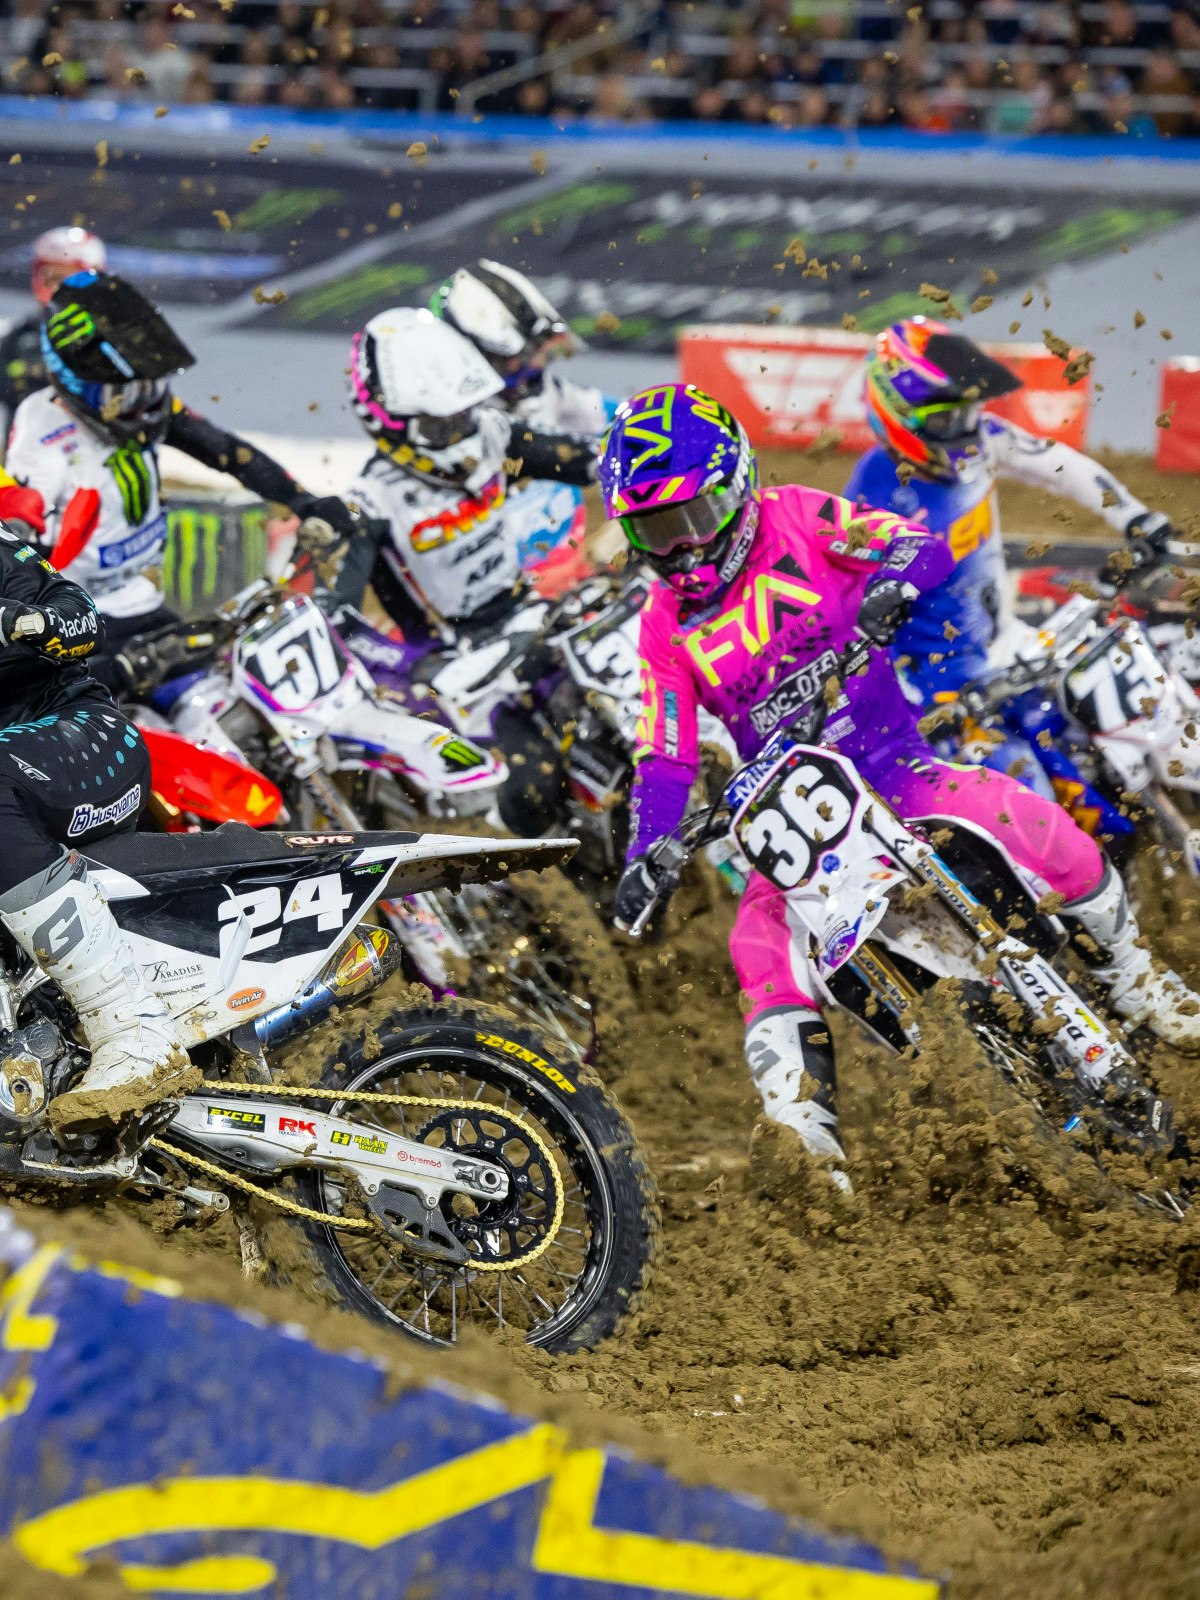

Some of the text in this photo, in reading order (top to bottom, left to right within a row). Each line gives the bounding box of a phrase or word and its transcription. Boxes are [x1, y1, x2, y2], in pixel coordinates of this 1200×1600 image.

[753, 653, 834, 733] MUC-OFF
[89, 787, 140, 827] Husqvarna
[747, 765, 852, 887] 36
[288, 835, 355, 845] GUTS
[353, 864, 386, 876] SMX
[218, 873, 354, 960] 24
[140, 961, 203, 982] PARADISE
[230, 990, 264, 1008] Twin Air
[483, 1034, 577, 1094] DUNLOP
[209, 1108, 264, 1125] EXCEL
[278, 1117, 318, 1137] RK
[353, 1135, 388, 1149] HAAN
[358, 1144, 387, 1155] WHEELS
[409, 1154, 443, 1169] brembo
